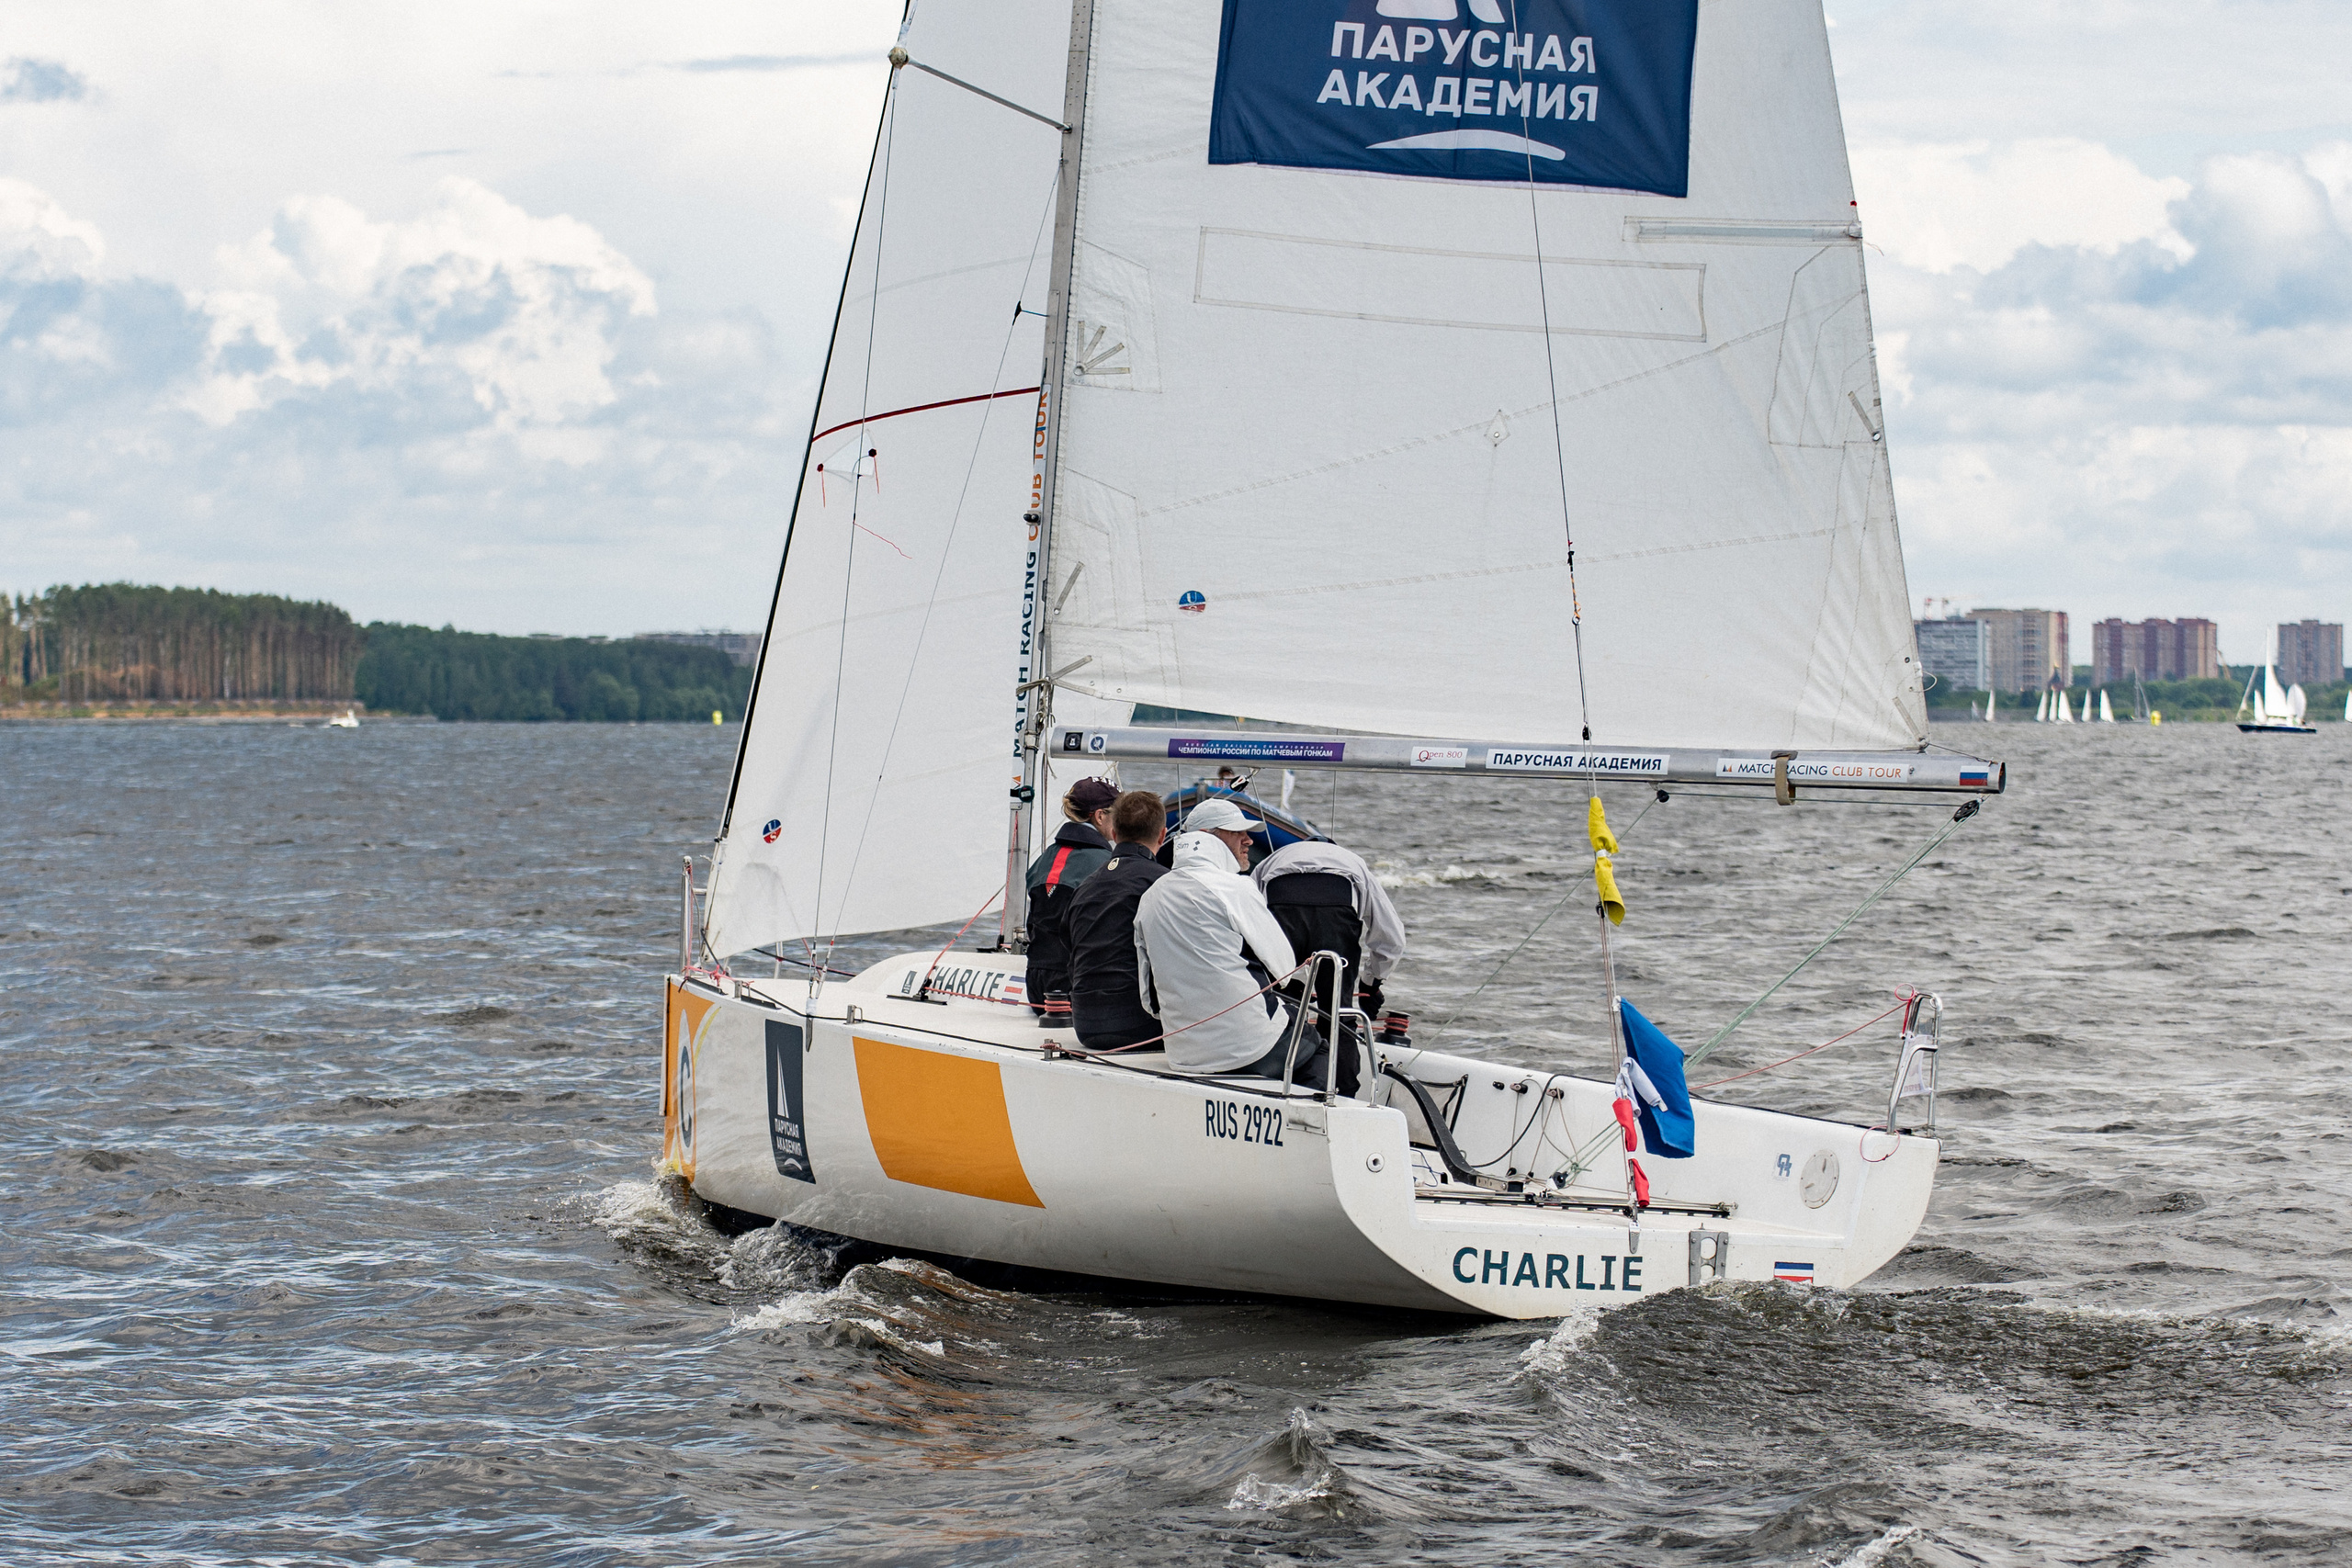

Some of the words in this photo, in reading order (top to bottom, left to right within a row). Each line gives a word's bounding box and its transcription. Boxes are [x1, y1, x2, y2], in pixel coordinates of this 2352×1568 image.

[1330, 21, 1597, 74] ПАРУСНАЯ
[1317, 69, 1599, 122] АКАДЕМИЯ
[1020, 550, 1036, 655] RACING
[1178, 747, 1222, 755] ЧЕМПИОНАТ
[1222, 748, 1250, 756] РОССИИ
[1250, 748, 1261, 756] ПО
[1261, 749, 1303, 757] МАТЧЕВЫМ
[1303, 749, 1333, 758] ГОНКАМ
[1446, 750, 1464, 759] 800
[1493, 752, 1574, 768] ПАРУСНАЯ
[1577, 756, 1663, 772] АКАДЕМИЯ
[1831, 765, 1863, 778] CLUB
[1868, 767, 1903, 779] TOUR
[926, 966, 1005, 1003] HARLIE
[1205, 1099, 1238, 1140] RUS
[1243, 1103, 1283, 1147] 2922
[1453, 1246, 1644, 1292] CHARLIE
